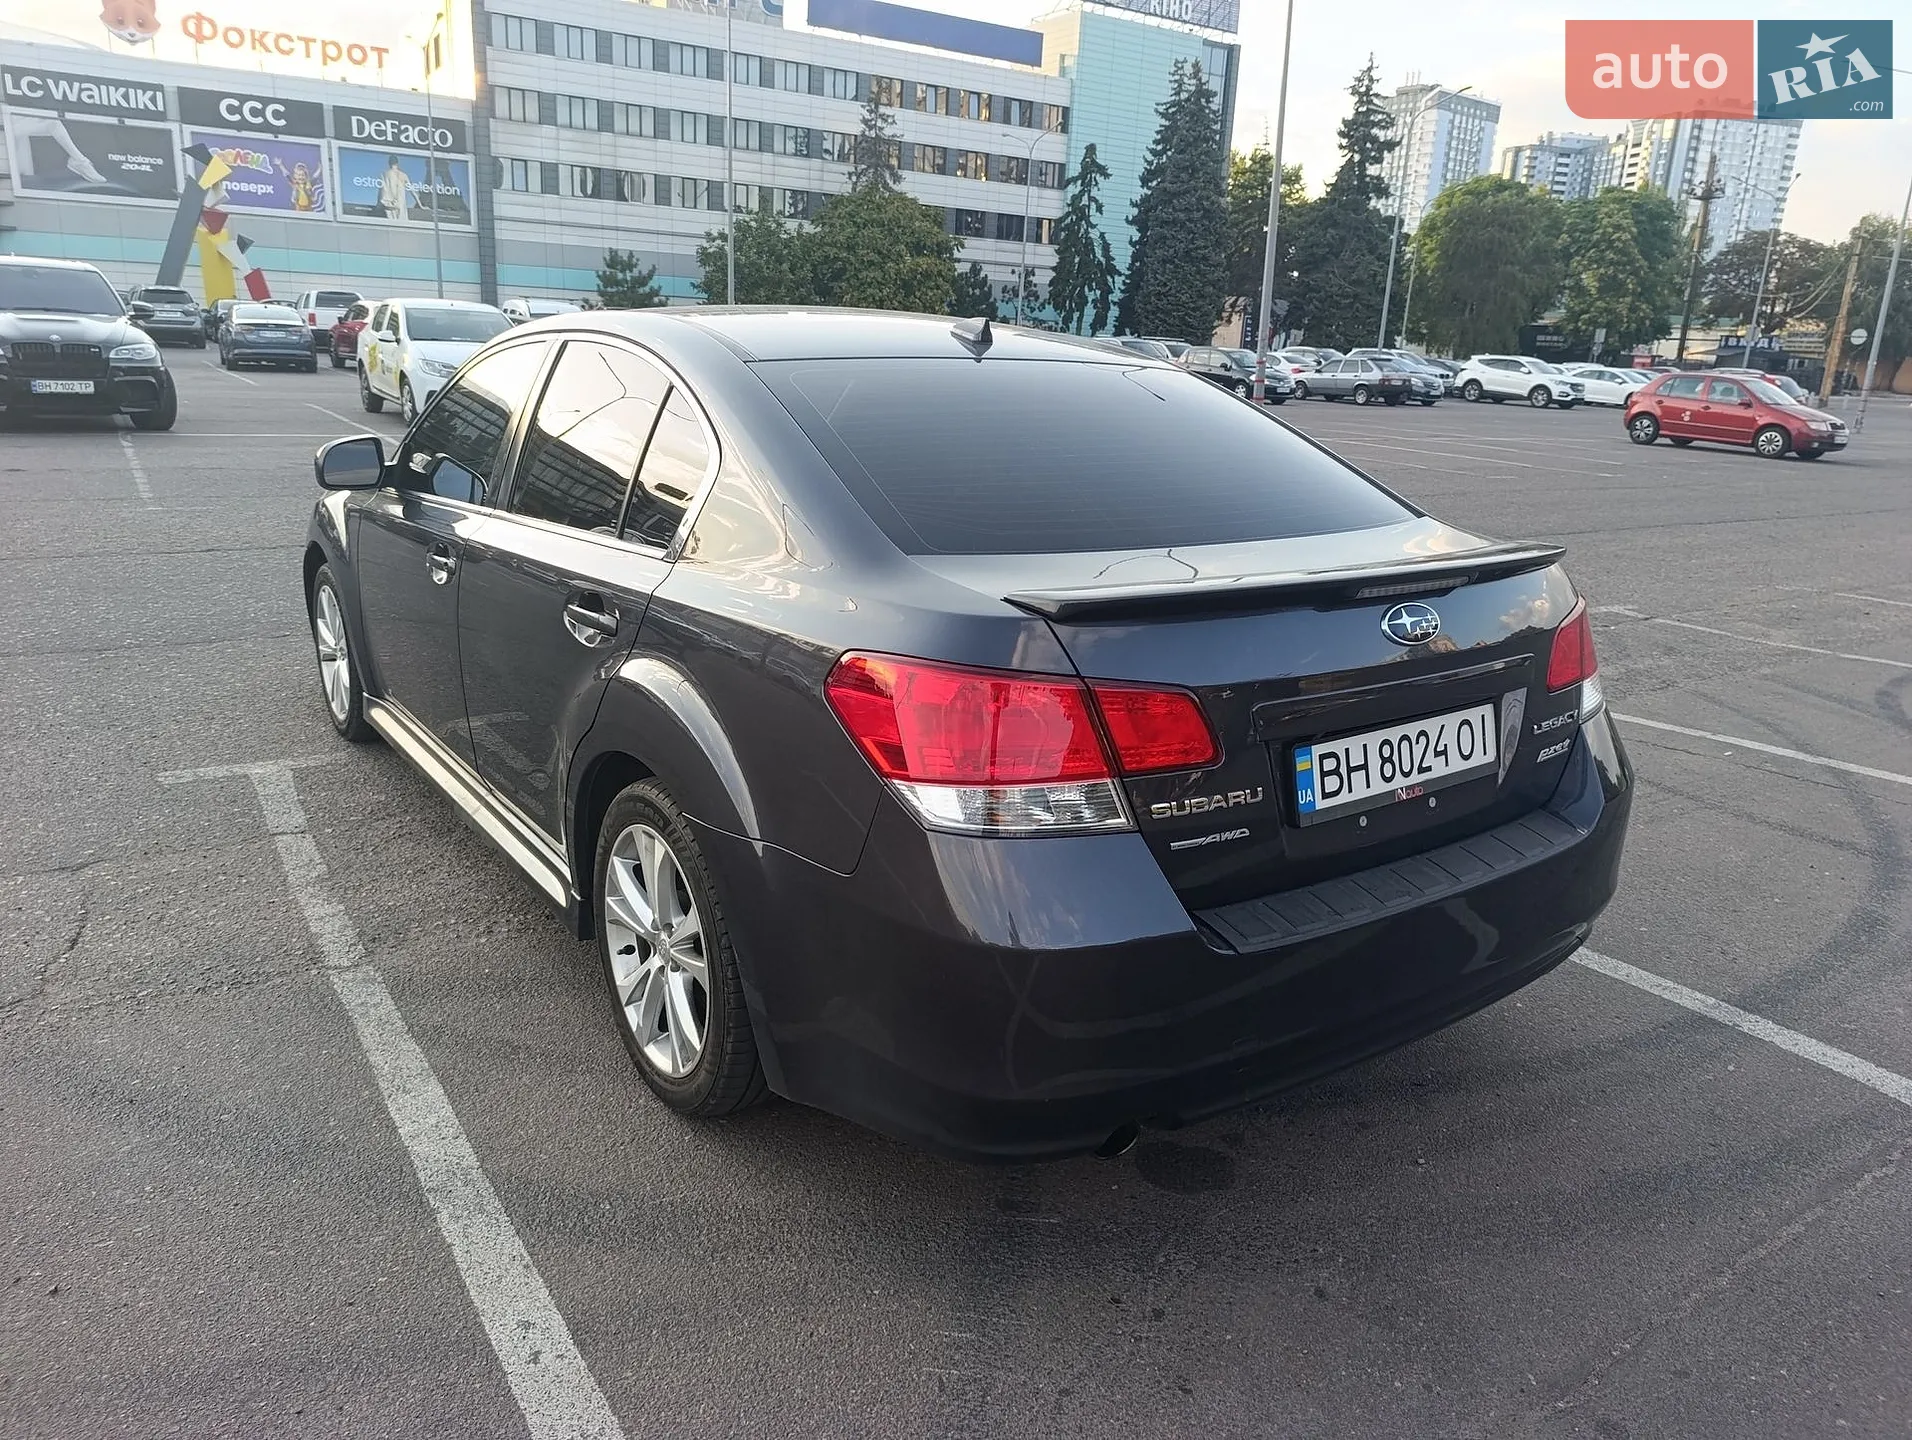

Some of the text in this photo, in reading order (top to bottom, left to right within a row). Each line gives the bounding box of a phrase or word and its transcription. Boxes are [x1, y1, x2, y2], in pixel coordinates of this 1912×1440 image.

[181, 12, 389, 68] Фокстрот
[4, 73, 44, 98] LC
[219, 98, 287, 126] CCC
[351, 115, 453, 148] DeFacto
[107, 153, 164, 165] new balance
[222, 181, 274, 195] поверх
[405, 180, 461, 196] selection
[37, 381, 52, 391] BH
[53, 382, 76, 391] 7102
[1318, 743, 1371, 801] BH
[1378, 723, 1449, 784] 8024
[1151, 787, 1263, 820] SUBARU
[1298, 788, 1314, 804] UA
